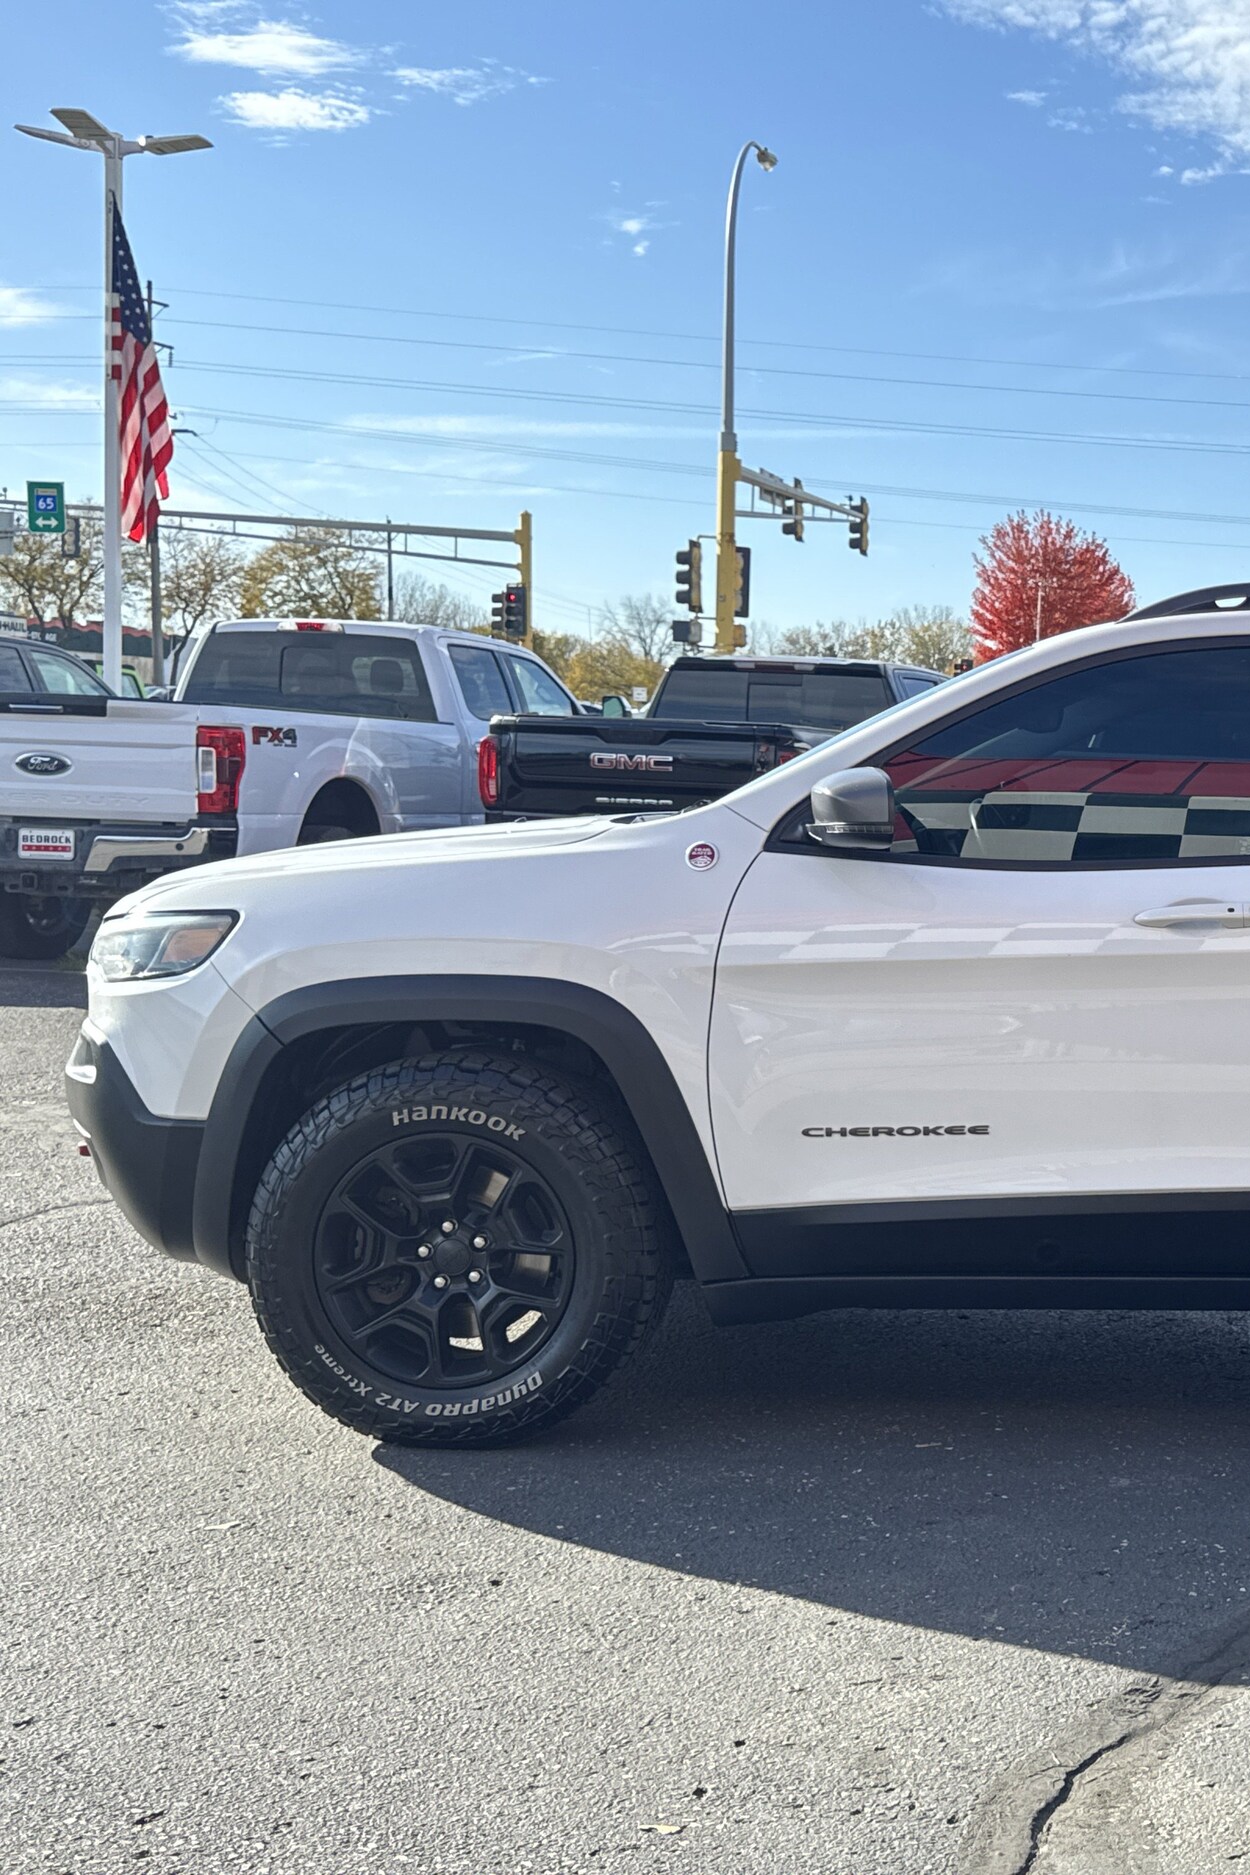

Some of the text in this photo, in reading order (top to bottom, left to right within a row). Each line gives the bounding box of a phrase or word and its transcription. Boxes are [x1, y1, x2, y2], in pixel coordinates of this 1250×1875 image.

[38, 497, 55, 510] 65
[252, 726, 297, 745] FX4
[27, 756, 59, 771] Ford
[590, 752, 674, 771] GMC
[595, 797, 673, 805] SIERRA
[22, 834, 72, 844] BEDROCK
[801, 1125, 990, 1137] CHEROKEE
[314, 1343, 373, 1397] Xtreme
[375, 1392, 420, 1414] AT2
